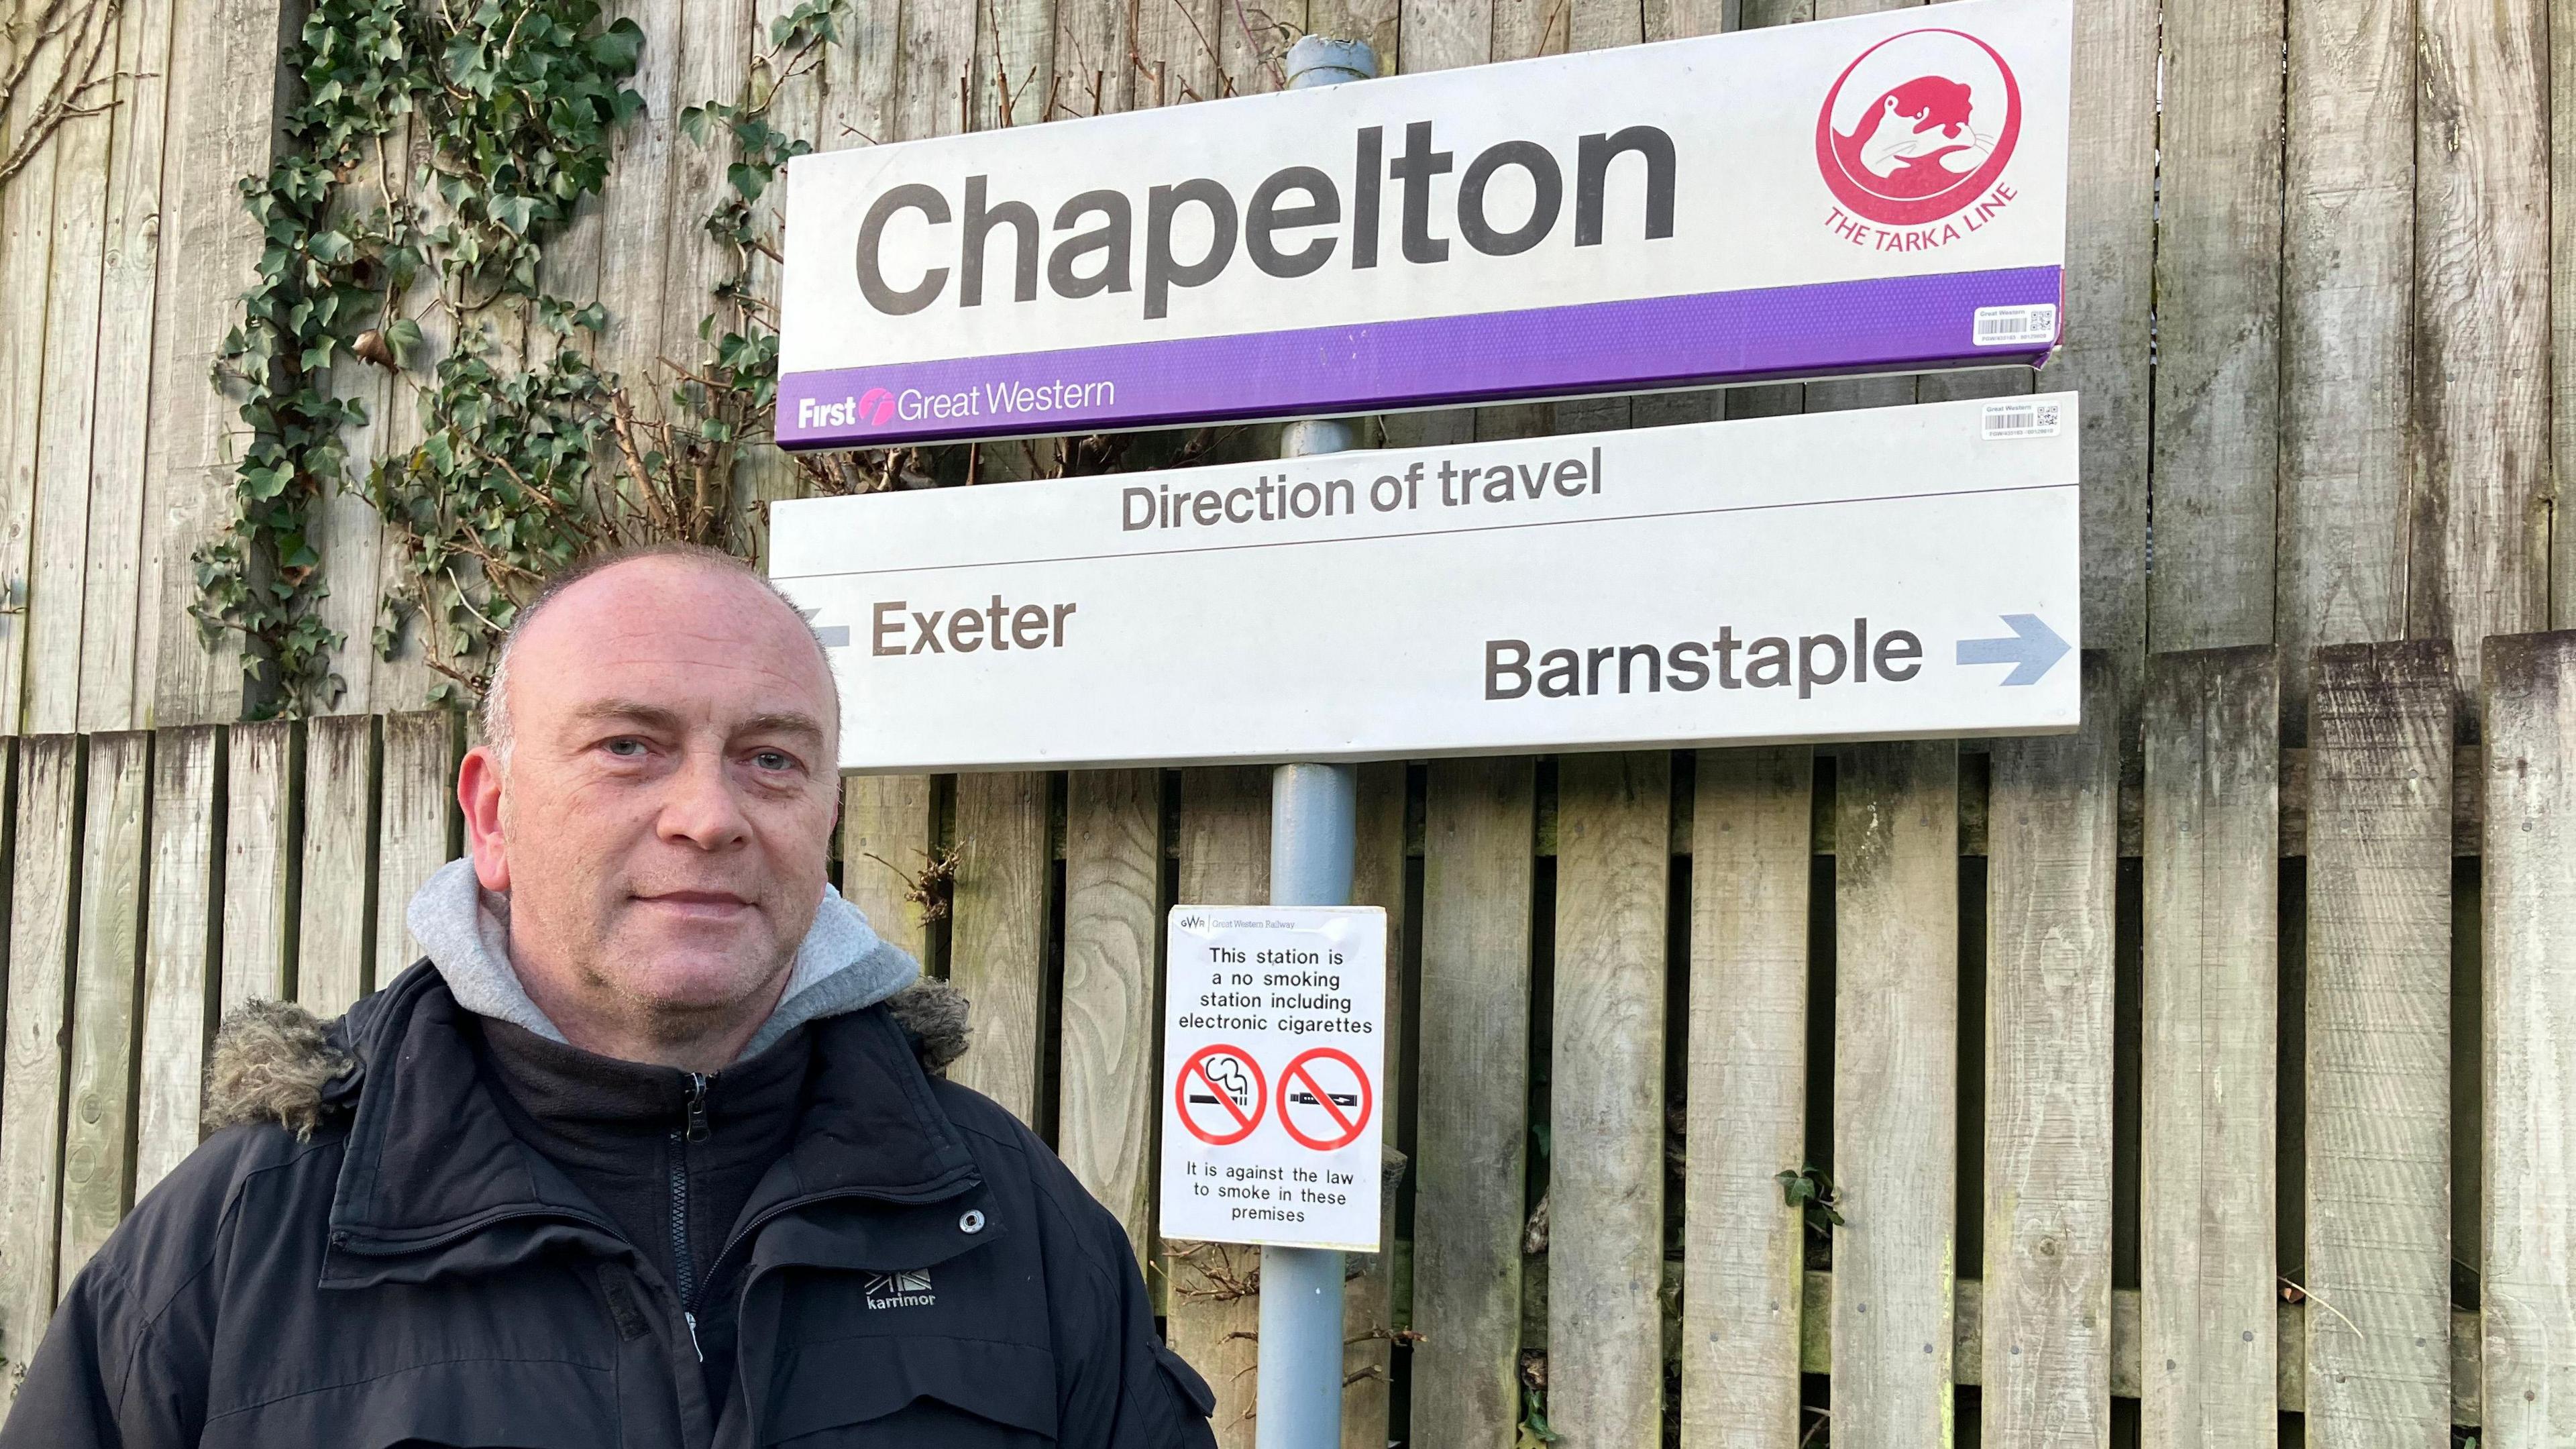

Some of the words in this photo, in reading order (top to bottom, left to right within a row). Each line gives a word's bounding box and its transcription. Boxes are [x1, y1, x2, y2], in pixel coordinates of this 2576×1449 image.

[857, 121, 1676, 320] Chapelton
[1825, 207, 1871, 246] THE
[1876, 224, 1961, 252] TARKA
[1963, 182, 2018, 232] LINE
[798, 396, 855, 429] First
[898, 386, 981, 421] Great
[985, 380, 1115, 414] Western
[1123, 474, 1354, 531] Direction
[1371, 462, 1424, 512] of
[1438, 447, 1601, 506] travel
[873, 595, 1077, 657] Exeter
[1485, 618, 1923, 700] Barnstaple
[1181, 915, 1205, 928] GWR
[1212, 920, 1232, 928] Great
[1234, 920, 1264, 928] Western
[1265, 920, 1295, 930] Railway
[1210, 947, 1246, 963] This
[1256, 948, 1319, 965] station
[1329, 949, 1343, 965] is
[1212, 973, 1222, 985] a
[1232, 974, 1253, 985] no
[1263, 971, 1340, 990] smoking
[1200, 991, 1261, 1008] station
[1271, 993, 1351, 1014] including
[1179, 1013, 1267, 1030] electronic
[1278, 1015, 1373, 1034] cigarettes
[1187, 1161, 1197, 1175] It
[1205, 1163, 1218, 1177] is
[1226, 1165, 1283, 1182] against
[1293, 1167, 1318, 1183] the
[1327, 1169, 1354, 1185] law
[1194, 1183, 1210, 1196] to
[1218, 1185, 1271, 1200] smoke
[1279, 1186, 1292, 1201] in
[1301, 1187, 1346, 1205] these
[1232, 1206, 1305, 1223] premises
[866, 1292, 936, 1309] karrimor
